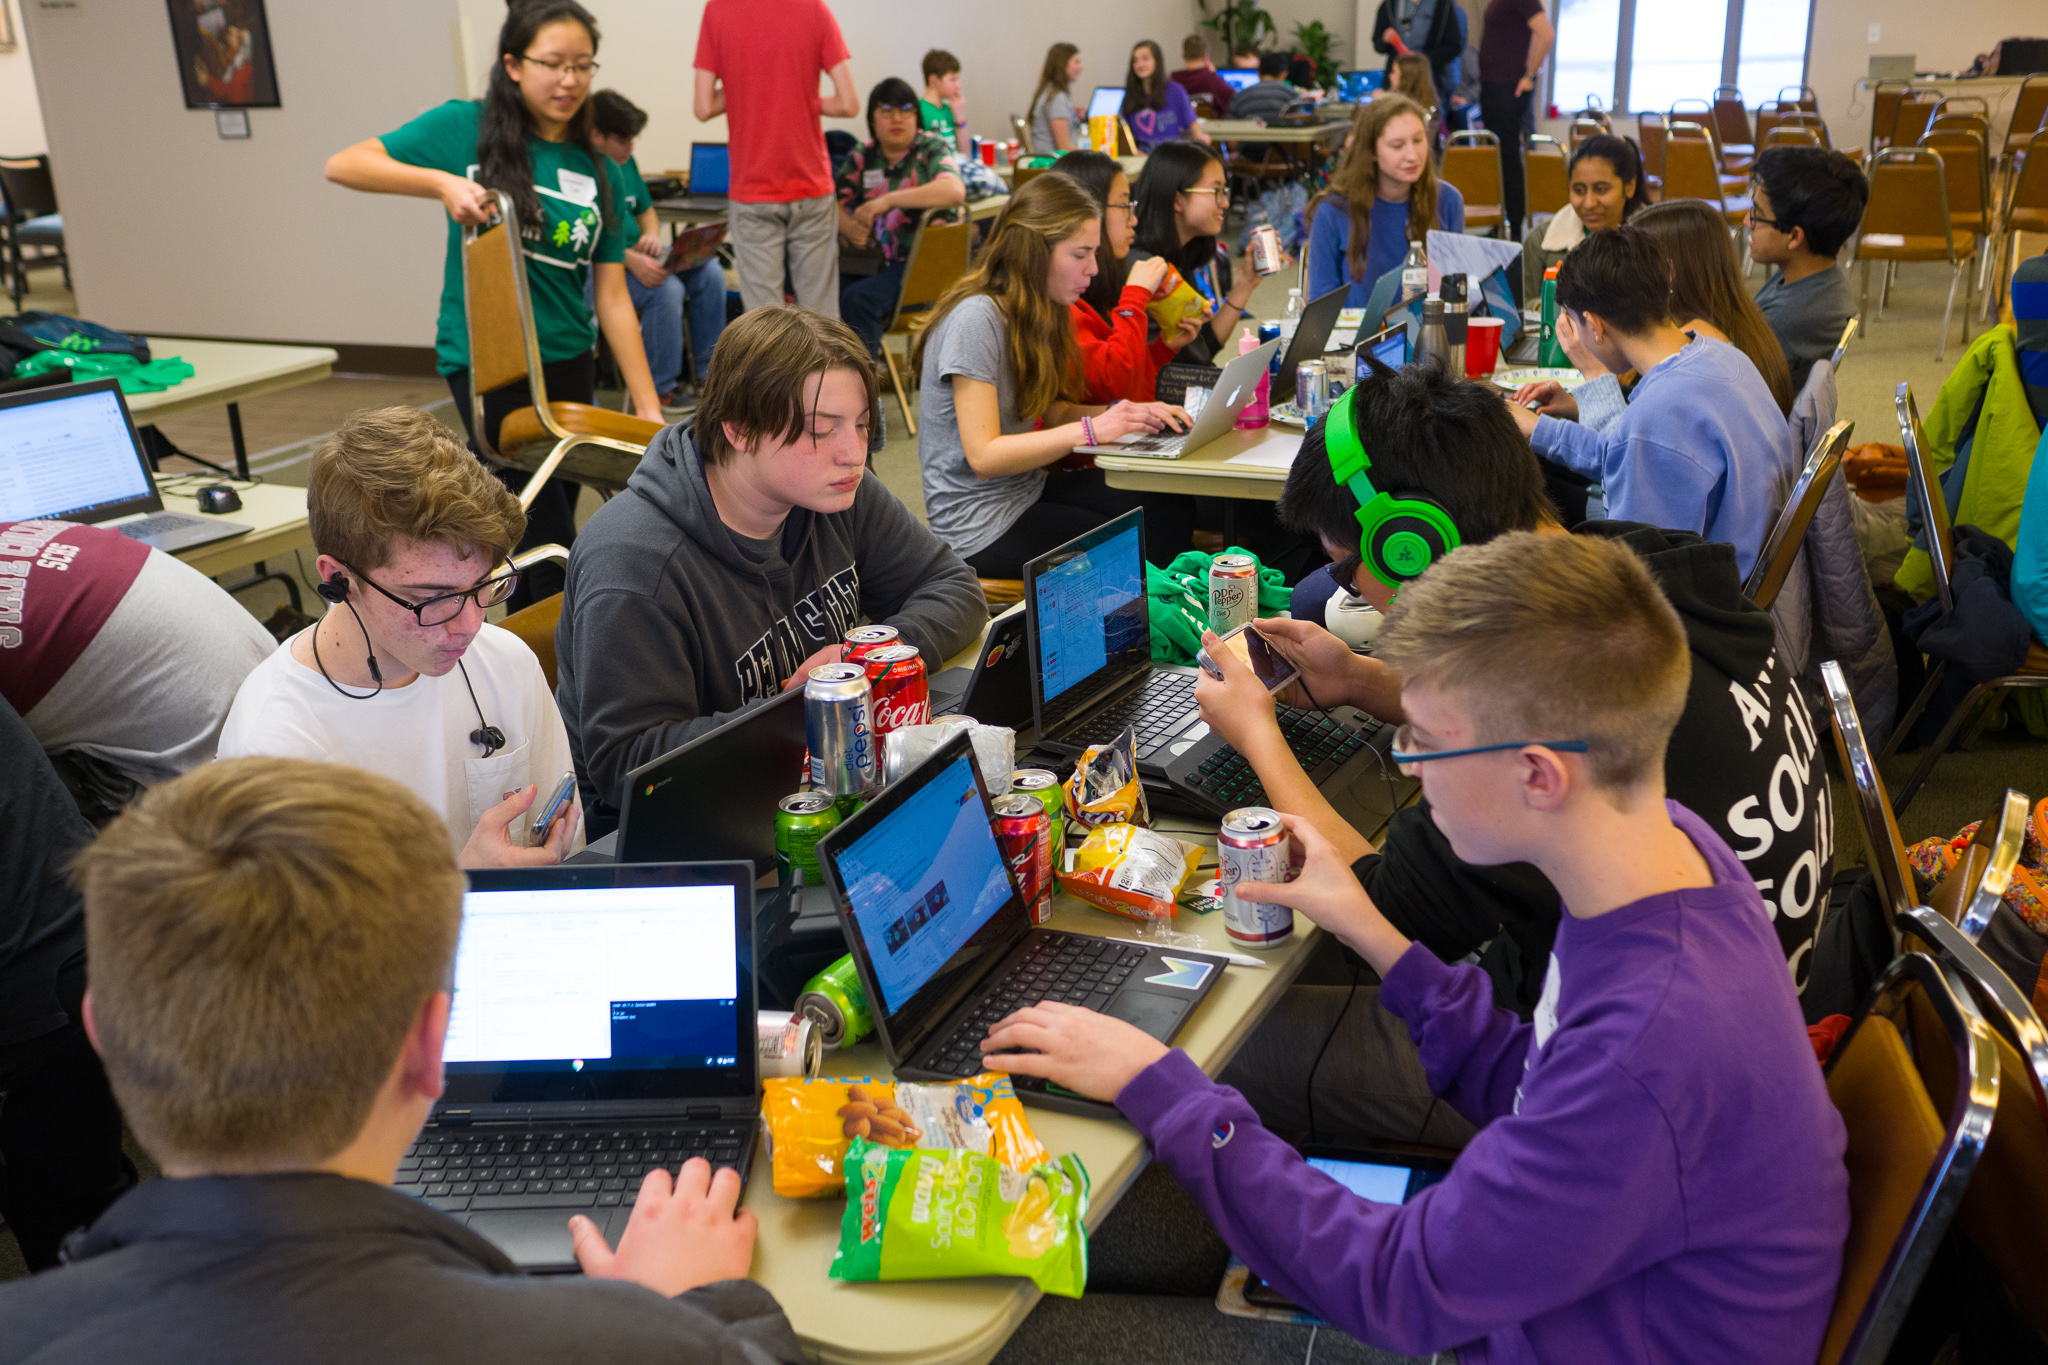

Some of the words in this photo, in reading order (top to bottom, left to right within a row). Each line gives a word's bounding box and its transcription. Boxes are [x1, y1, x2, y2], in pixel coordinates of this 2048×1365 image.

[36, 542, 80, 571] SCHS
[1212, 590, 1241, 607] Pepper
[892, 664, 919, 674] ORIGINAL
[848, 703, 872, 769] pepsi
[843, 748, 854, 771] diet
[911, 1155, 944, 1224] wavy
[955, 1155, 985, 1226] Onion
